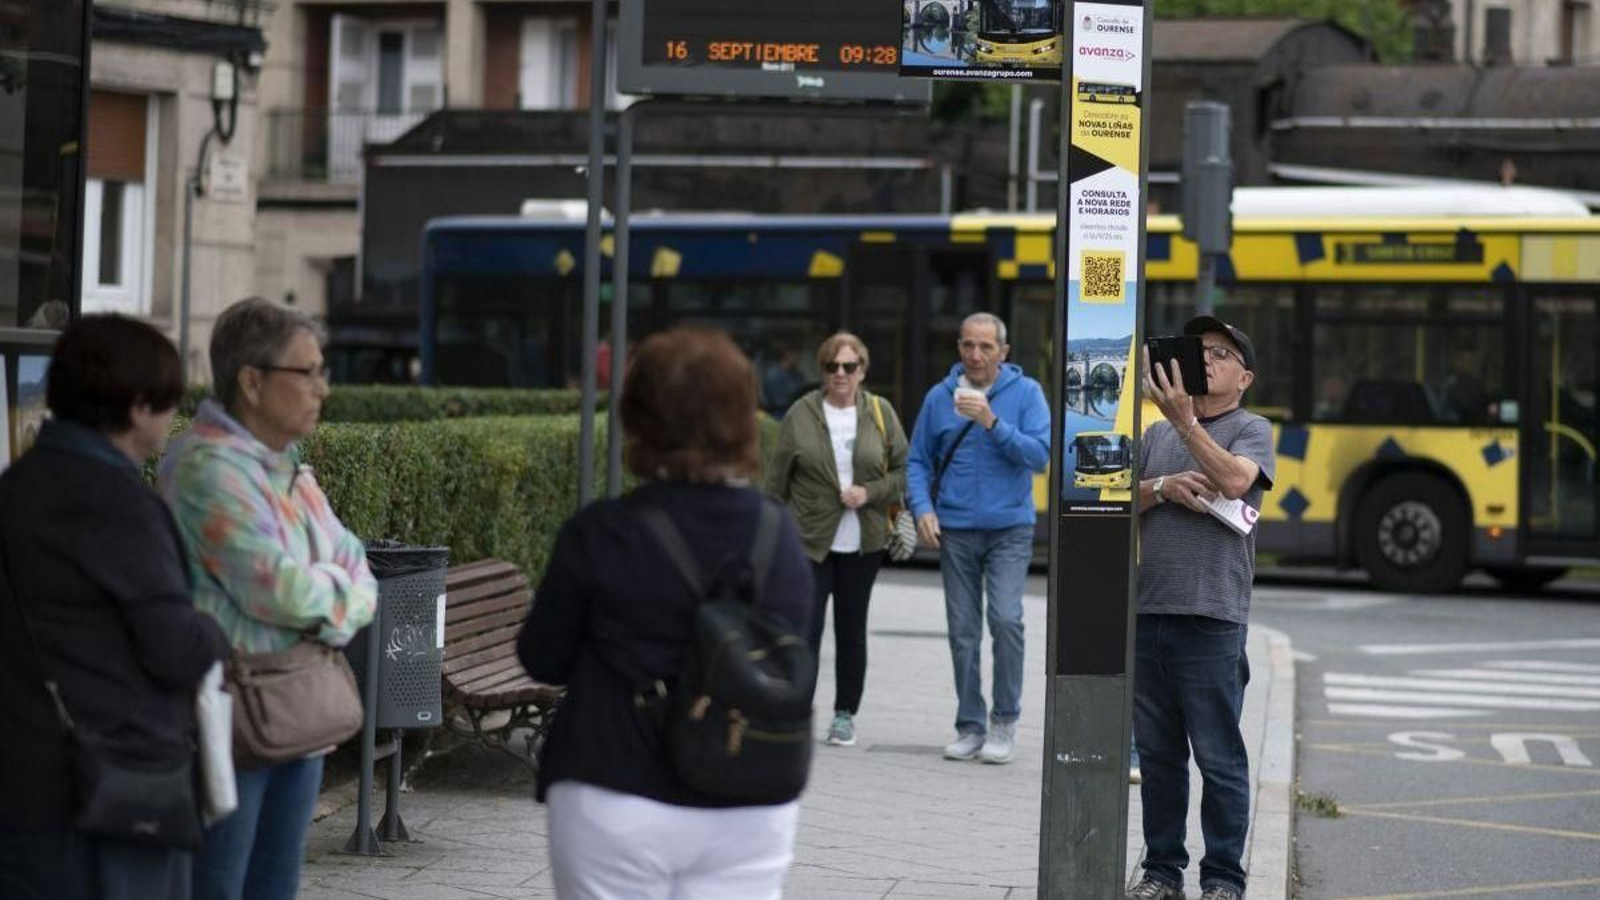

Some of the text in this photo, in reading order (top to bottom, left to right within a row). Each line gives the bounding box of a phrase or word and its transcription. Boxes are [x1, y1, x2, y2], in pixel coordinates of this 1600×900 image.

[1096, 24, 1135, 34] OURENSE
[666, 41, 897, 65] 16 SEPTIEMBRE 09:28
[1079, 46, 1124, 58] avanza
[932, 69, 1033, 78] ourense.avanzagrupo.com
[1078, 120, 1133, 130] NOVAS LIÑAS
[1091, 129, 1131, 139] OURENSE
[1081, 189, 1127, 199] CONSULTA
[1077, 198, 1131, 208] A NOVA REDE
[1084, 207, 1130, 216] HORARIOS
